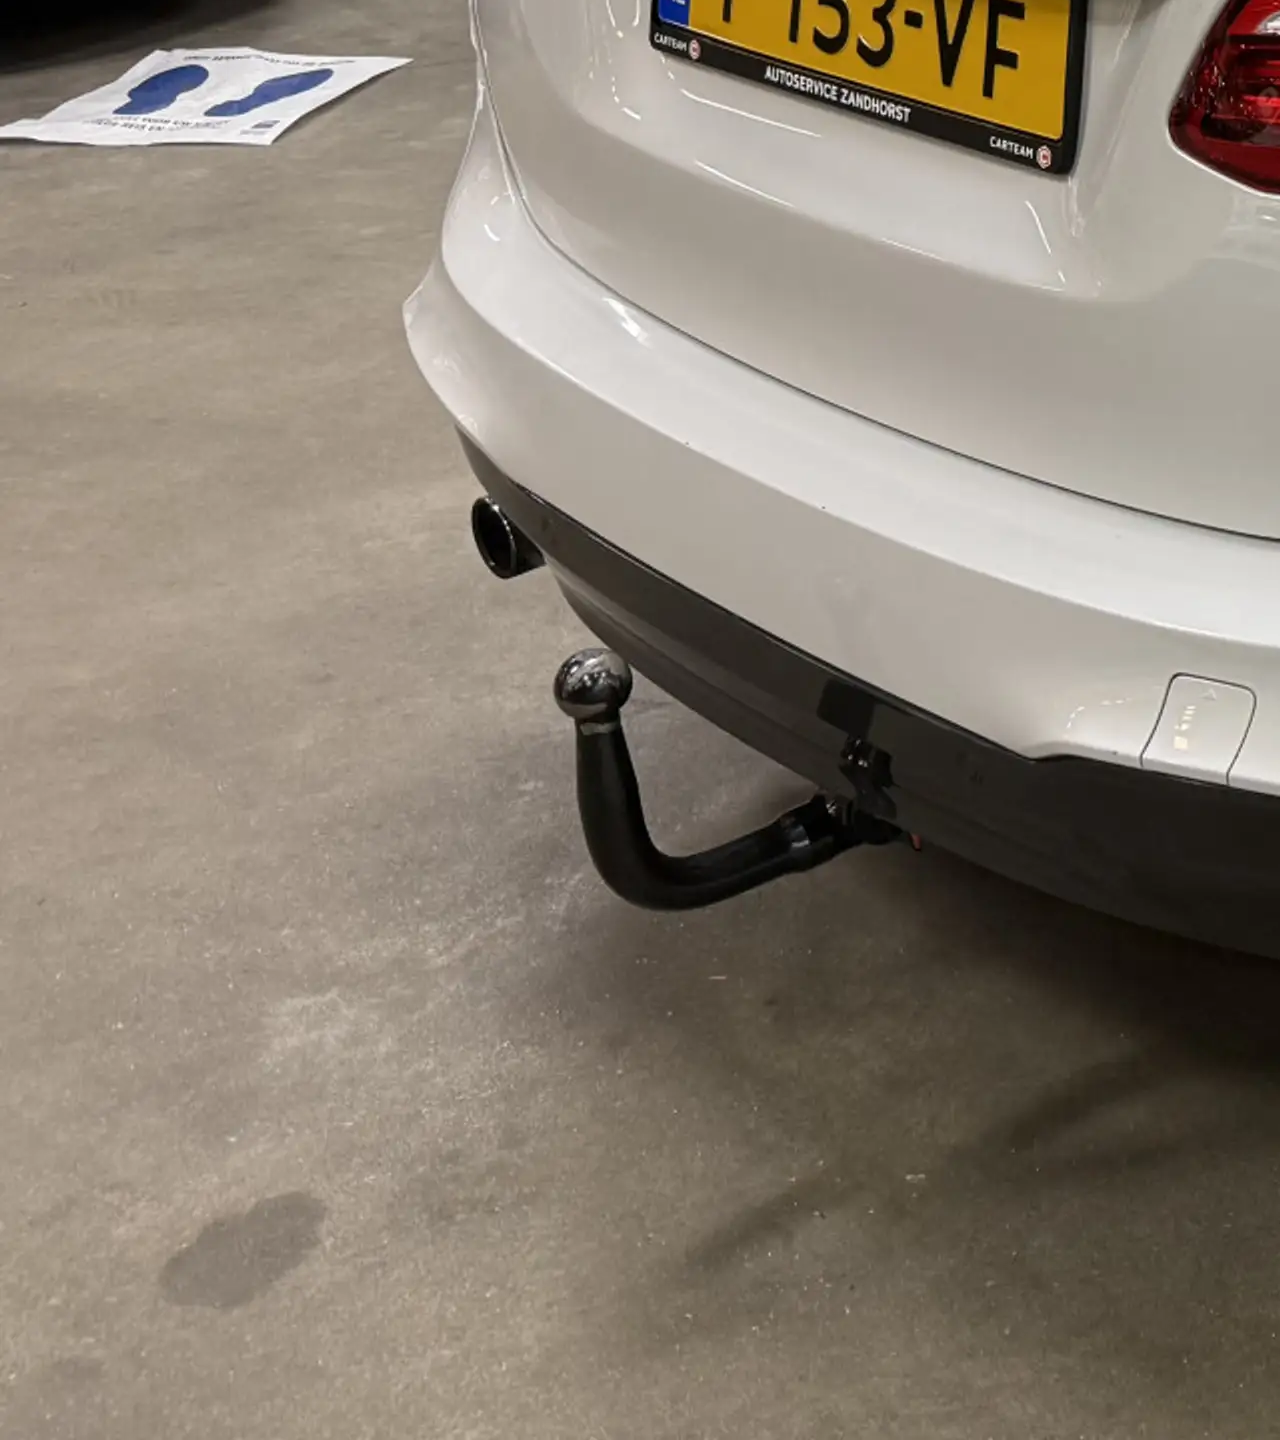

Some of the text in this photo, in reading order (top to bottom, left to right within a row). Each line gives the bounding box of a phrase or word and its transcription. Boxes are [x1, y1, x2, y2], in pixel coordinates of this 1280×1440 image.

[653, 31, 688, 53] CARTEAM
[763, 64, 911, 124] AUTOSERVICE ZANDHORST
[989, 135, 1034, 160] CARTEAM
